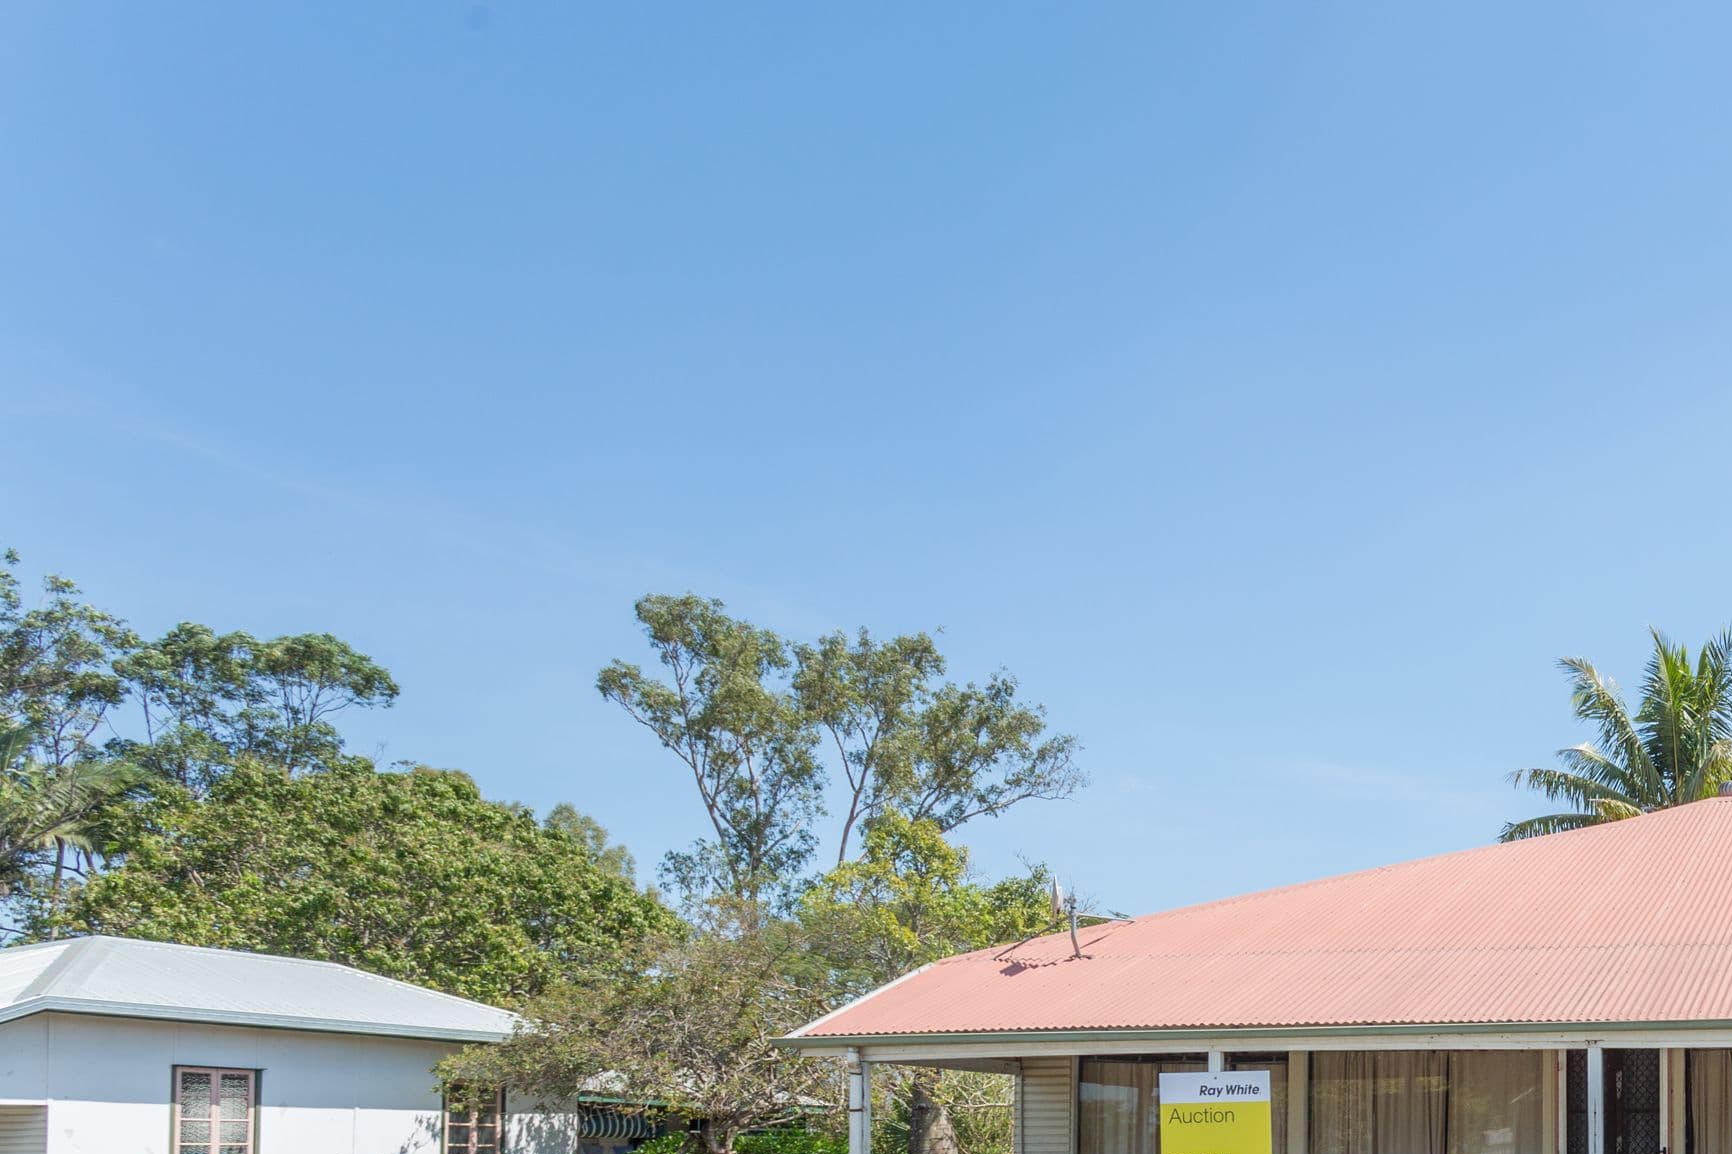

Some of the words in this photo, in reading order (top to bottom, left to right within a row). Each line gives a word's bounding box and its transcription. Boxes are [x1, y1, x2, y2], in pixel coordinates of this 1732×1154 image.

[1199, 1085, 1223, 1098] Ray
[1225, 1084, 1260, 1095] White
[1168, 1107, 1235, 1124] Auction
